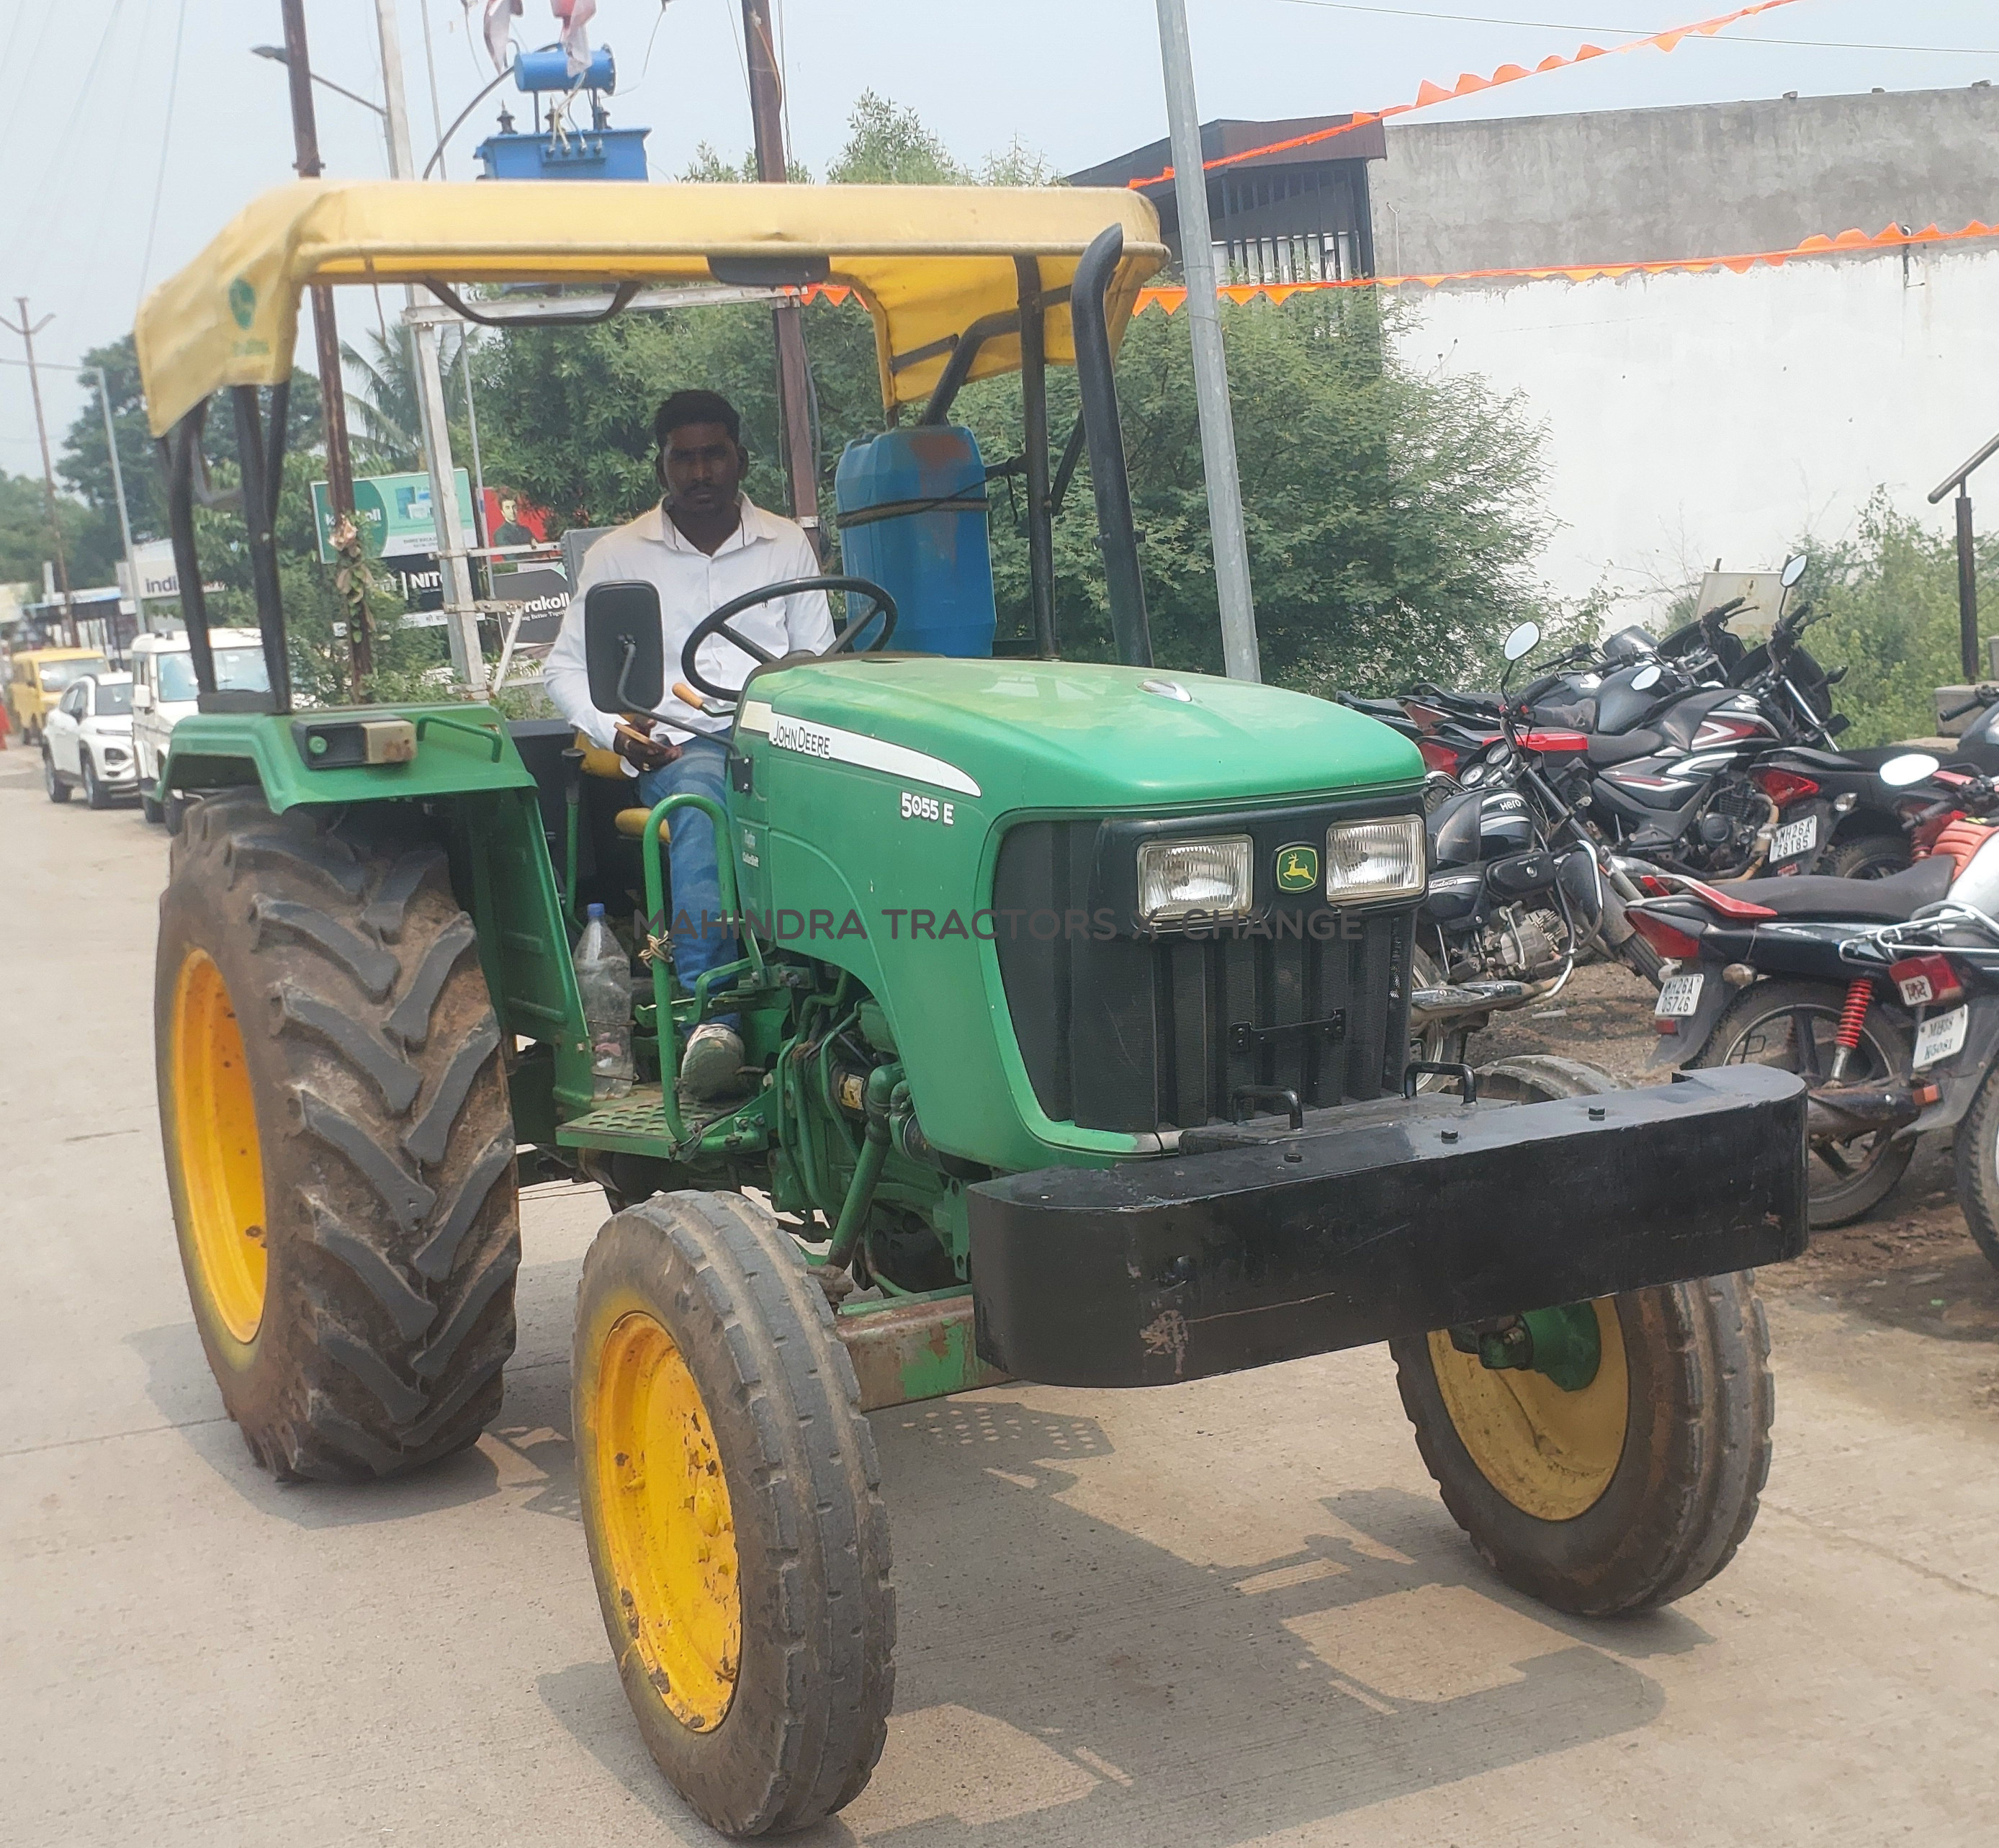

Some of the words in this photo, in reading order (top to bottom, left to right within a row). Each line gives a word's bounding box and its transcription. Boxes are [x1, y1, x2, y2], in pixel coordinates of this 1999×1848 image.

[145, 576, 178, 593] indi
[410, 571, 443, 589] NIT
[506, 592, 570, 615] rakoll
[773, 721, 797, 749] JOHN
[799, 726, 830, 755] DEERE
[901, 791, 939, 820] 5055
[943, 802, 954, 825] E
[1499, 799, 1522, 811] Hero
[1779, 821, 1810, 843] MH26A
[1777, 835, 1809, 858] Z8185
